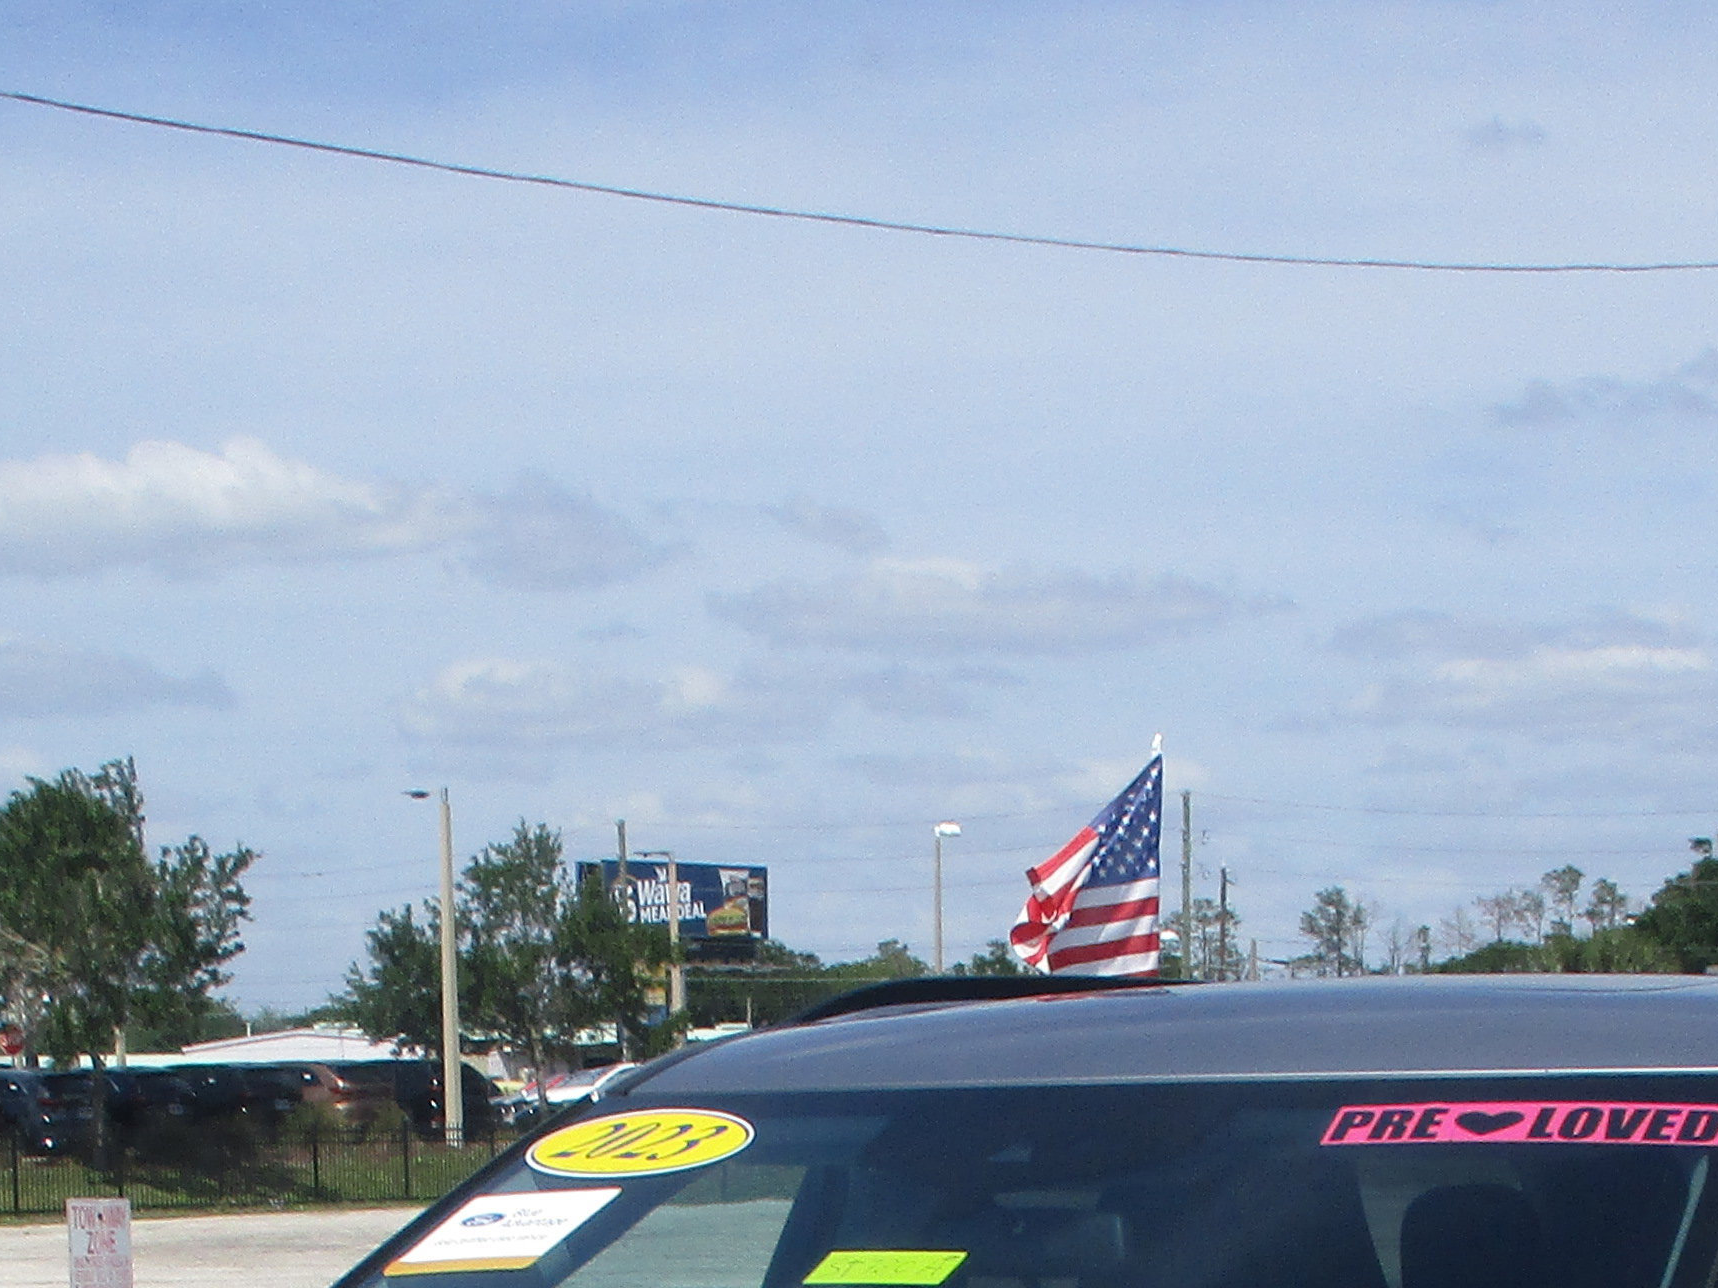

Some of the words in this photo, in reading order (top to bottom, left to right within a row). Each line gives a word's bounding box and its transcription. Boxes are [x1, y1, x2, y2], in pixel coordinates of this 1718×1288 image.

[676, 901, 707, 919] DEAL
[547, 1122, 729, 1160] 2023
[1329, 1107, 1450, 1142] PRE
